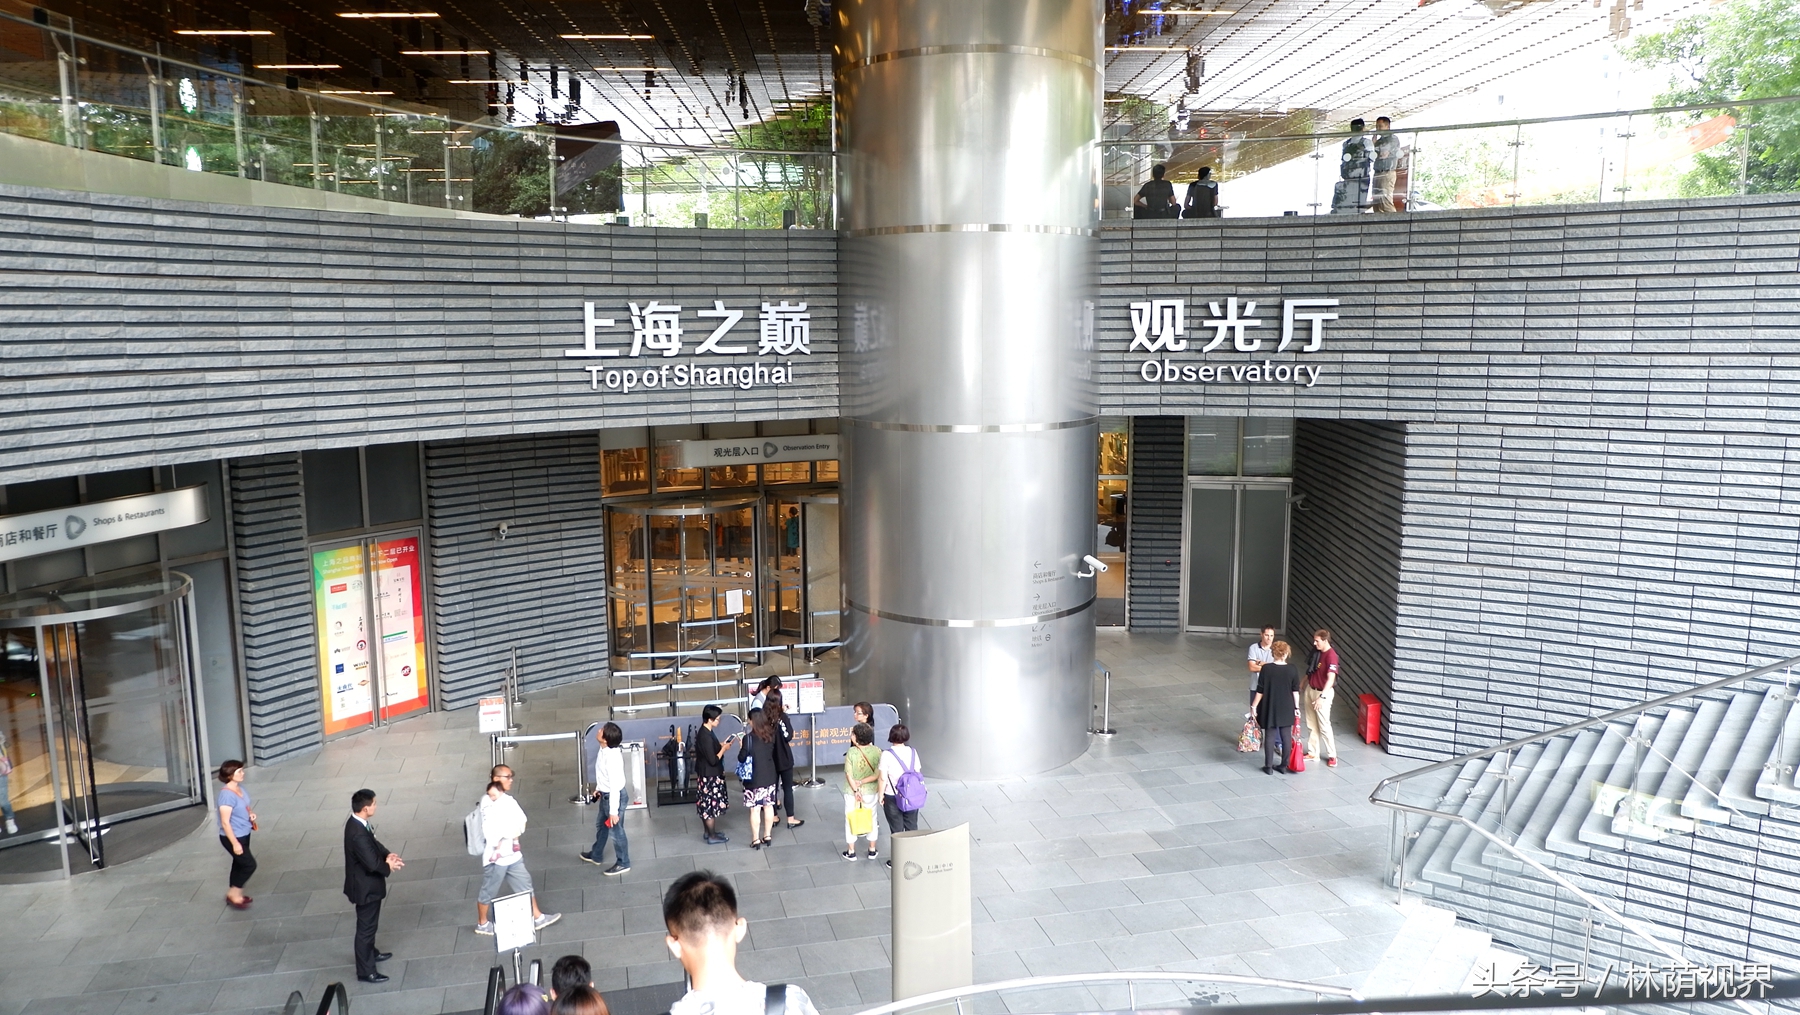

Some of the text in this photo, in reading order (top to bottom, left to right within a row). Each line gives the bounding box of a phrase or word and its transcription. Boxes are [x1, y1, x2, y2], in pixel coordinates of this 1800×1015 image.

[564, 300, 811, 357] 上海之巅
[1129, 297, 1340, 353] 观光厅
[585, 361, 793, 393] Top of Shanghai
[1140, 359, 1322, 387] Observatory
[713, 446, 759, 458] 观光层入口
[782, 443, 830, 452] Observation Entry
[93, 507, 165, 526] Shops & Restaurants
